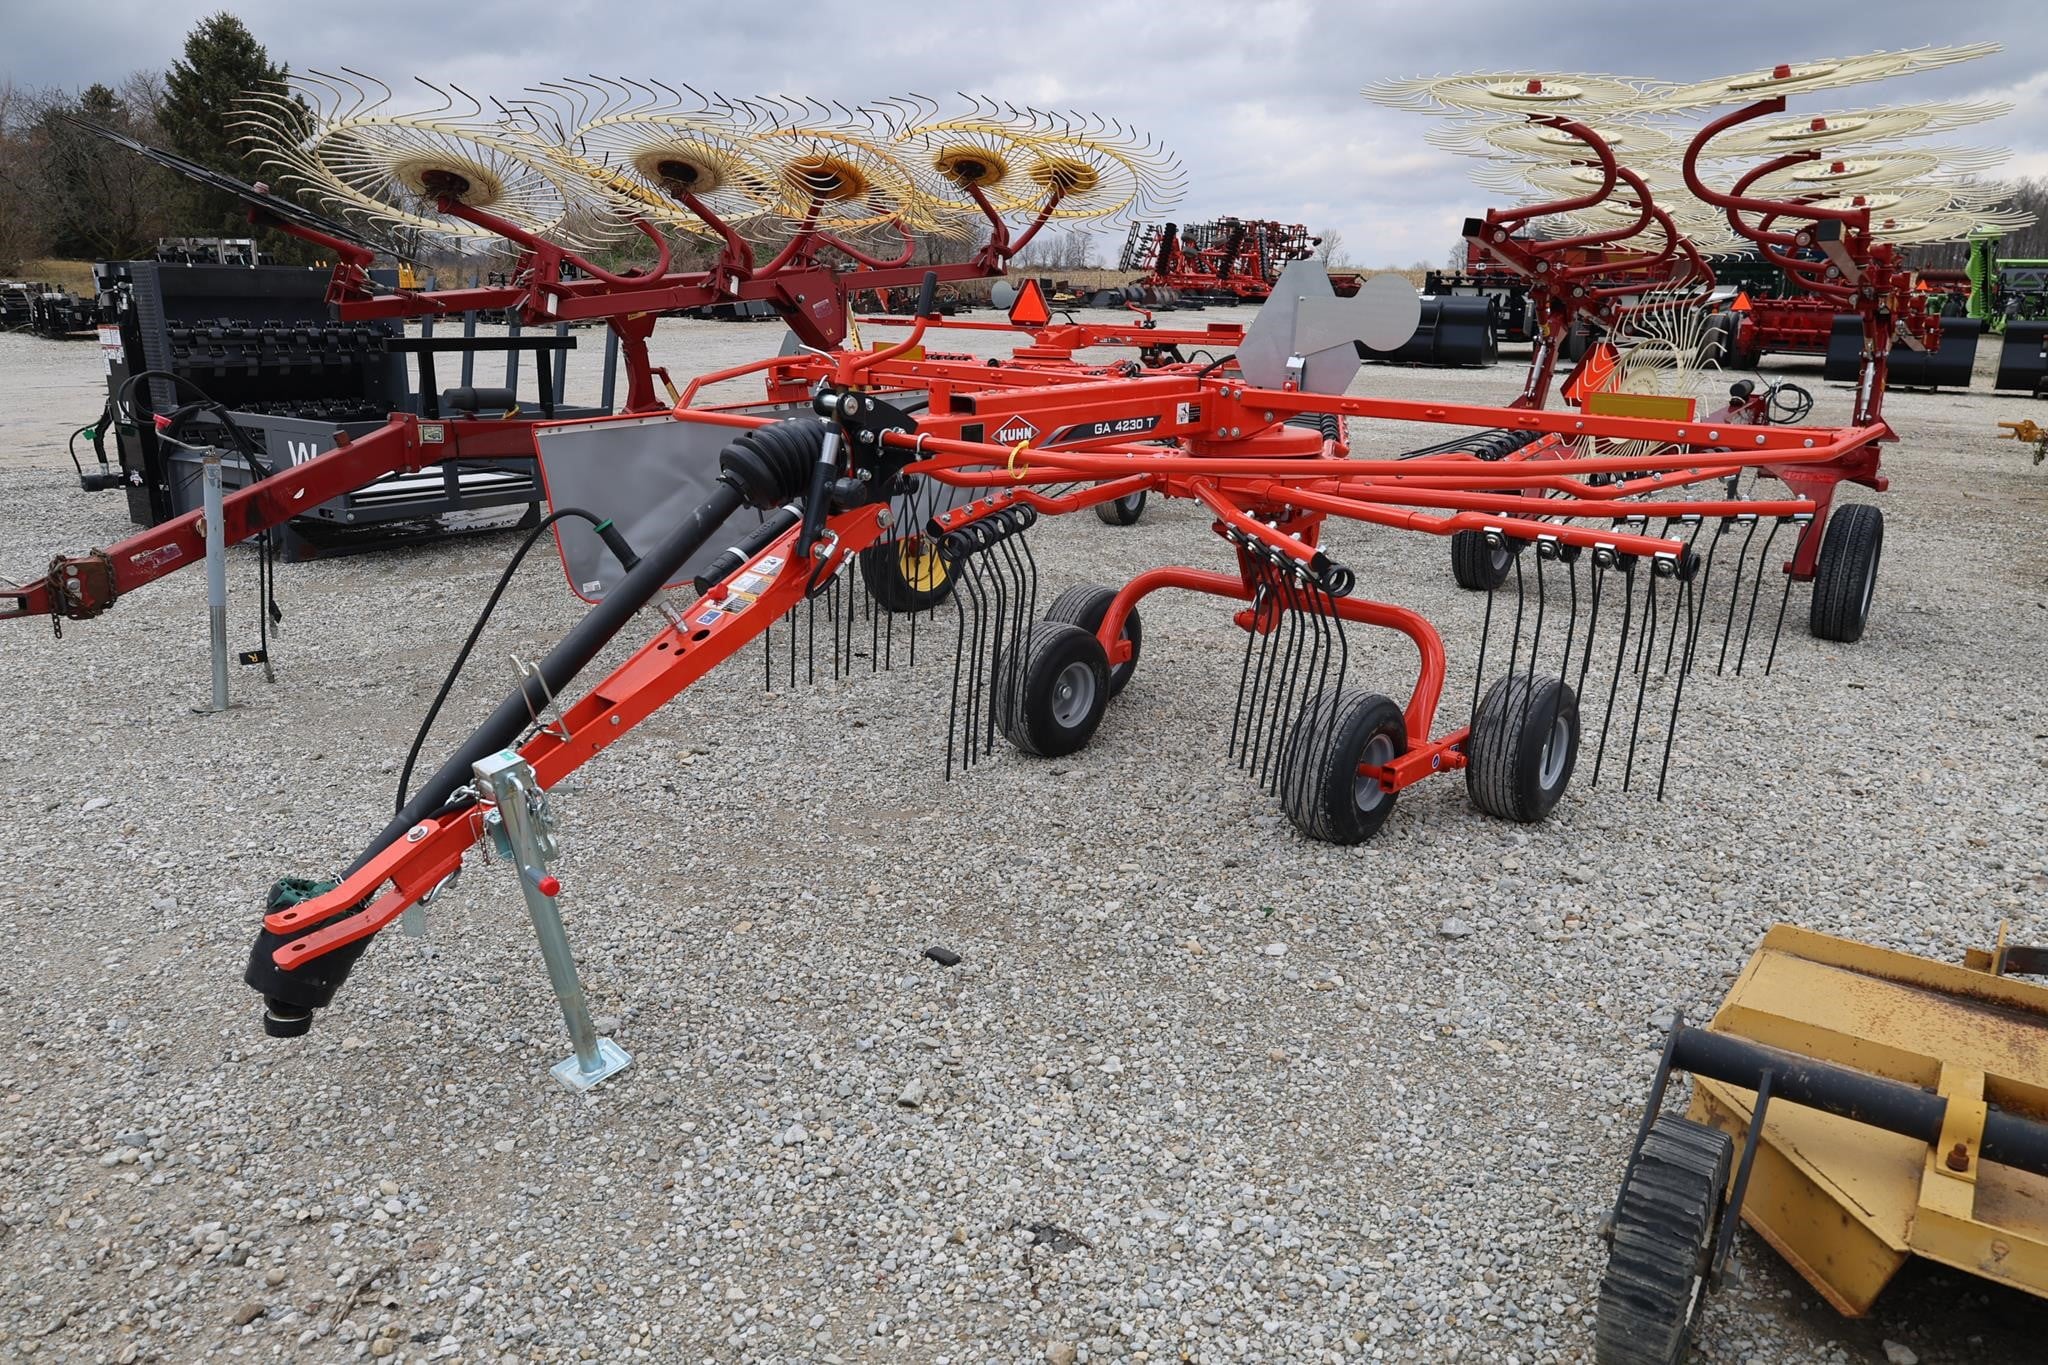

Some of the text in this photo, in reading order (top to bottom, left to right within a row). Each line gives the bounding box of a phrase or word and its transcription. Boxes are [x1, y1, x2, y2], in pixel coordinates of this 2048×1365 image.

[1094, 417, 1154, 435] GA 4230 T
[1000, 427, 1032, 442] KUHN
